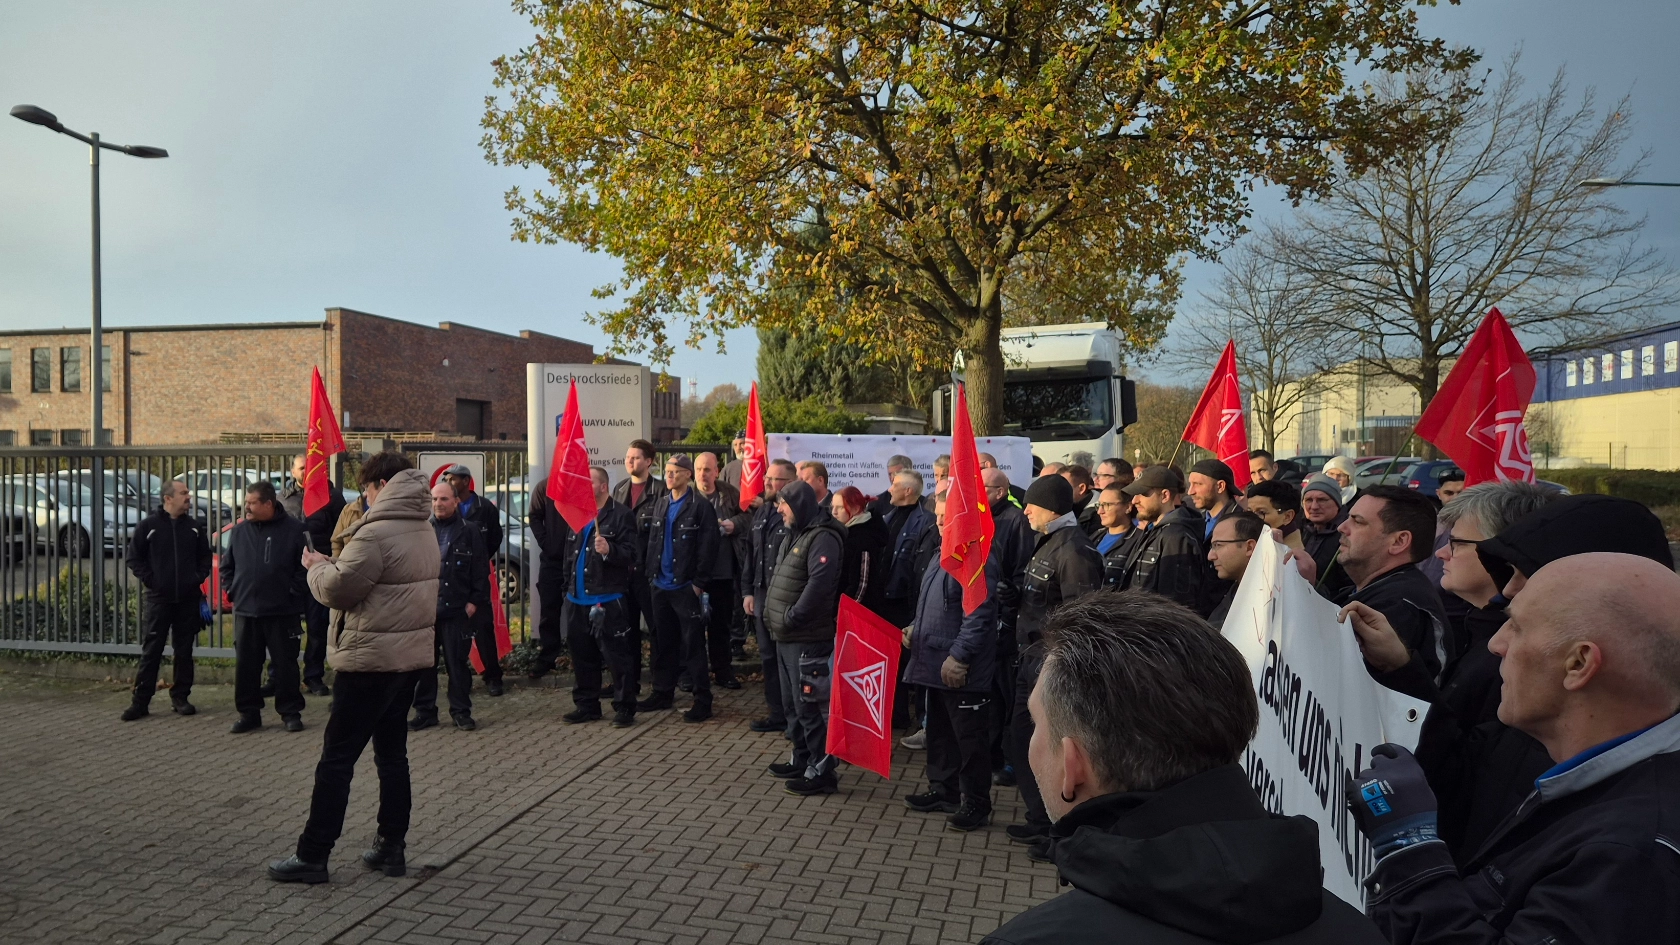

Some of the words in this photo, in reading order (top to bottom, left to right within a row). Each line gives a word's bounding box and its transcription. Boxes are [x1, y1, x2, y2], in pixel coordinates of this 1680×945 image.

[547, 372, 631, 385] Desbrocksriede
[634, 374, 639, 386] 3
[607, 418, 635, 427] AluTech
[811, 451, 854, 459] Rheinmetall
[612, 457, 626, 465] Gmb
[860, 461, 885, 470] Waffen,
[828, 470, 847, 478] zivile
[848, 470, 880, 478] Geschäft
[828, 480, 854, 488] haffen?
[1299, 690, 1332, 811] uns
